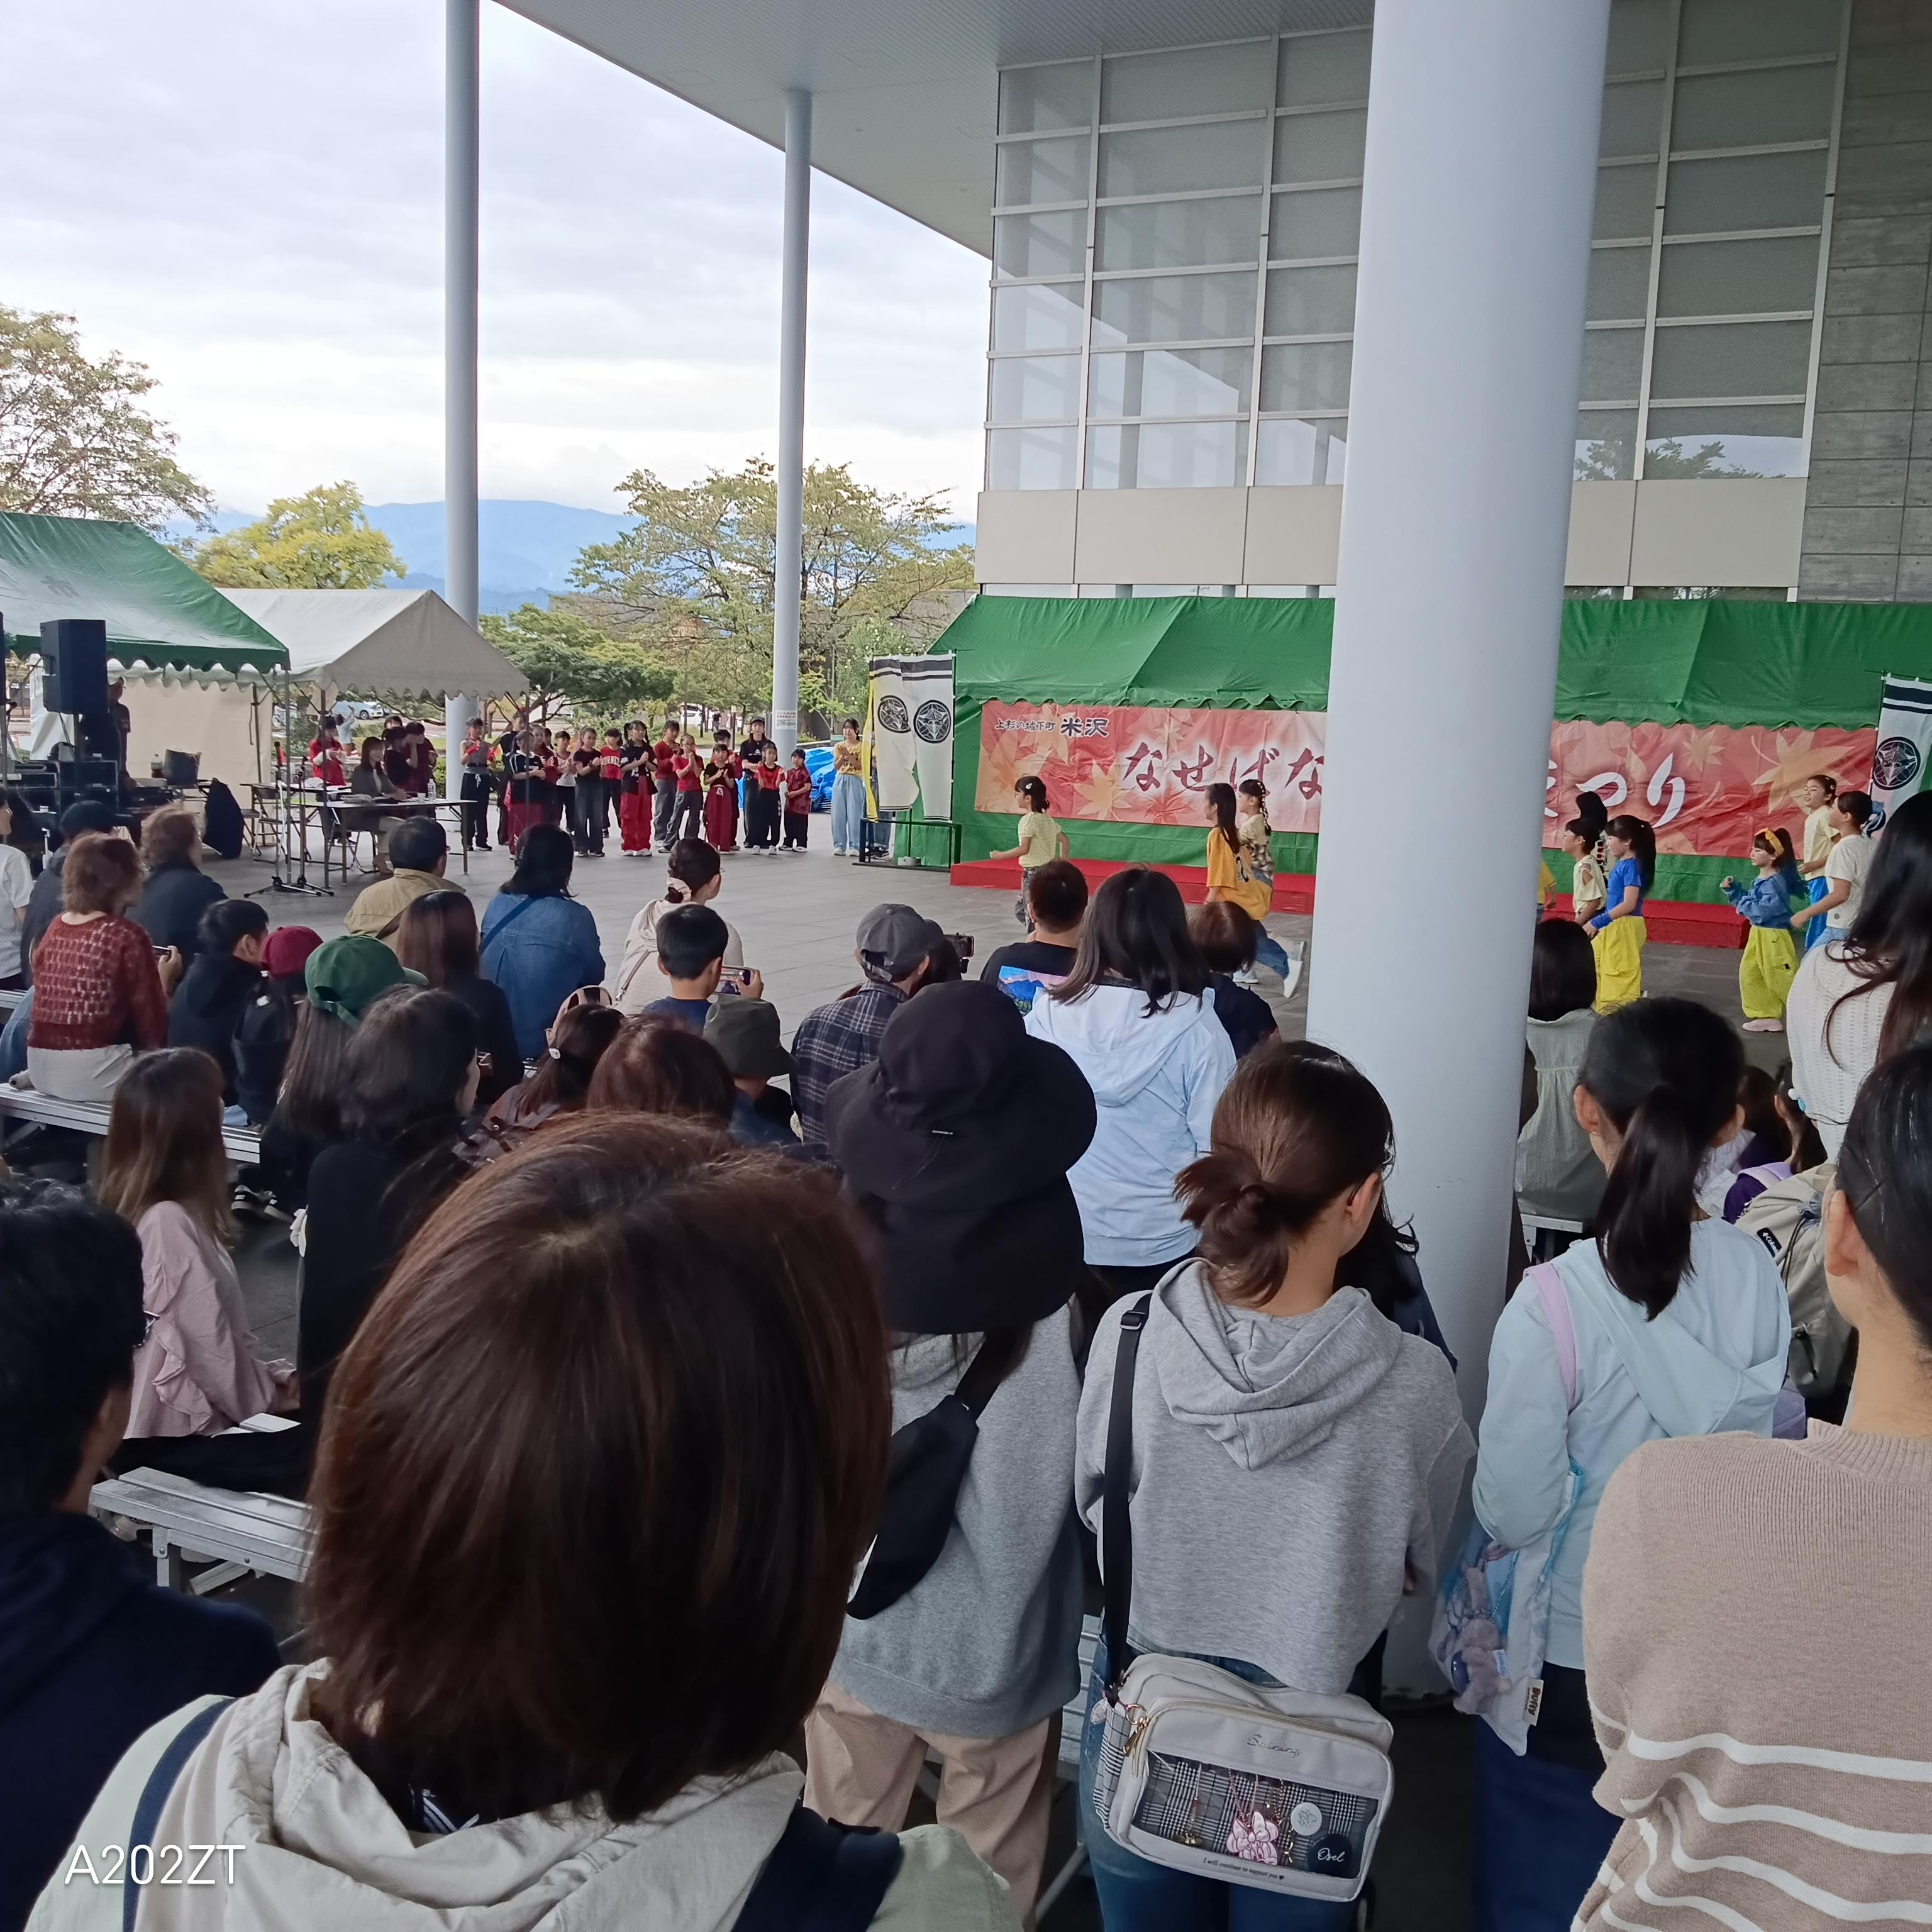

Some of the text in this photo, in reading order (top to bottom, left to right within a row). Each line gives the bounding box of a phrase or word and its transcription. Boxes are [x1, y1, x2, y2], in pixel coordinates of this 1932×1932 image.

[996, 718, 1109, 737] 上杉の城下町 米沢
[1545, 753, 1685, 829] つり
